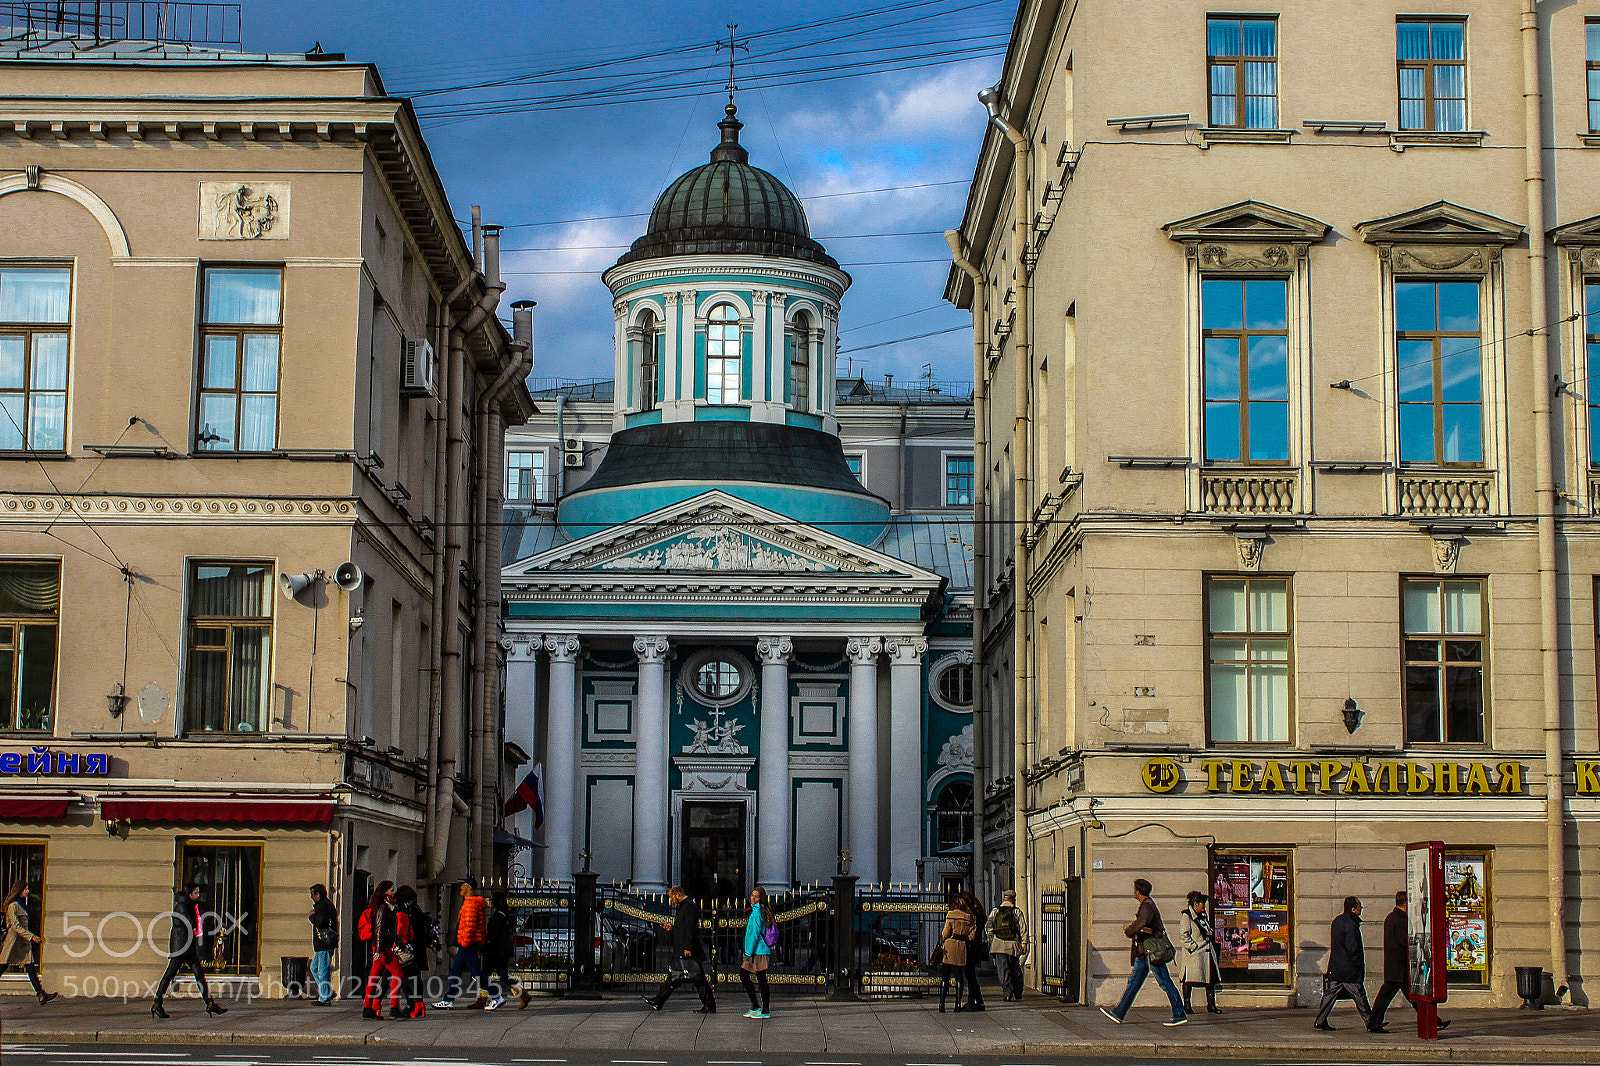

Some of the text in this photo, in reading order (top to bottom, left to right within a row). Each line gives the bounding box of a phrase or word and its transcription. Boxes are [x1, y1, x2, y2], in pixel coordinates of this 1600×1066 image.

[0, 746, 107, 773] ейня
[1201, 760, 1523, 793] ТЕАТРАЛЬНАЯ
[1257, 924, 1279, 932] ТОСКА
